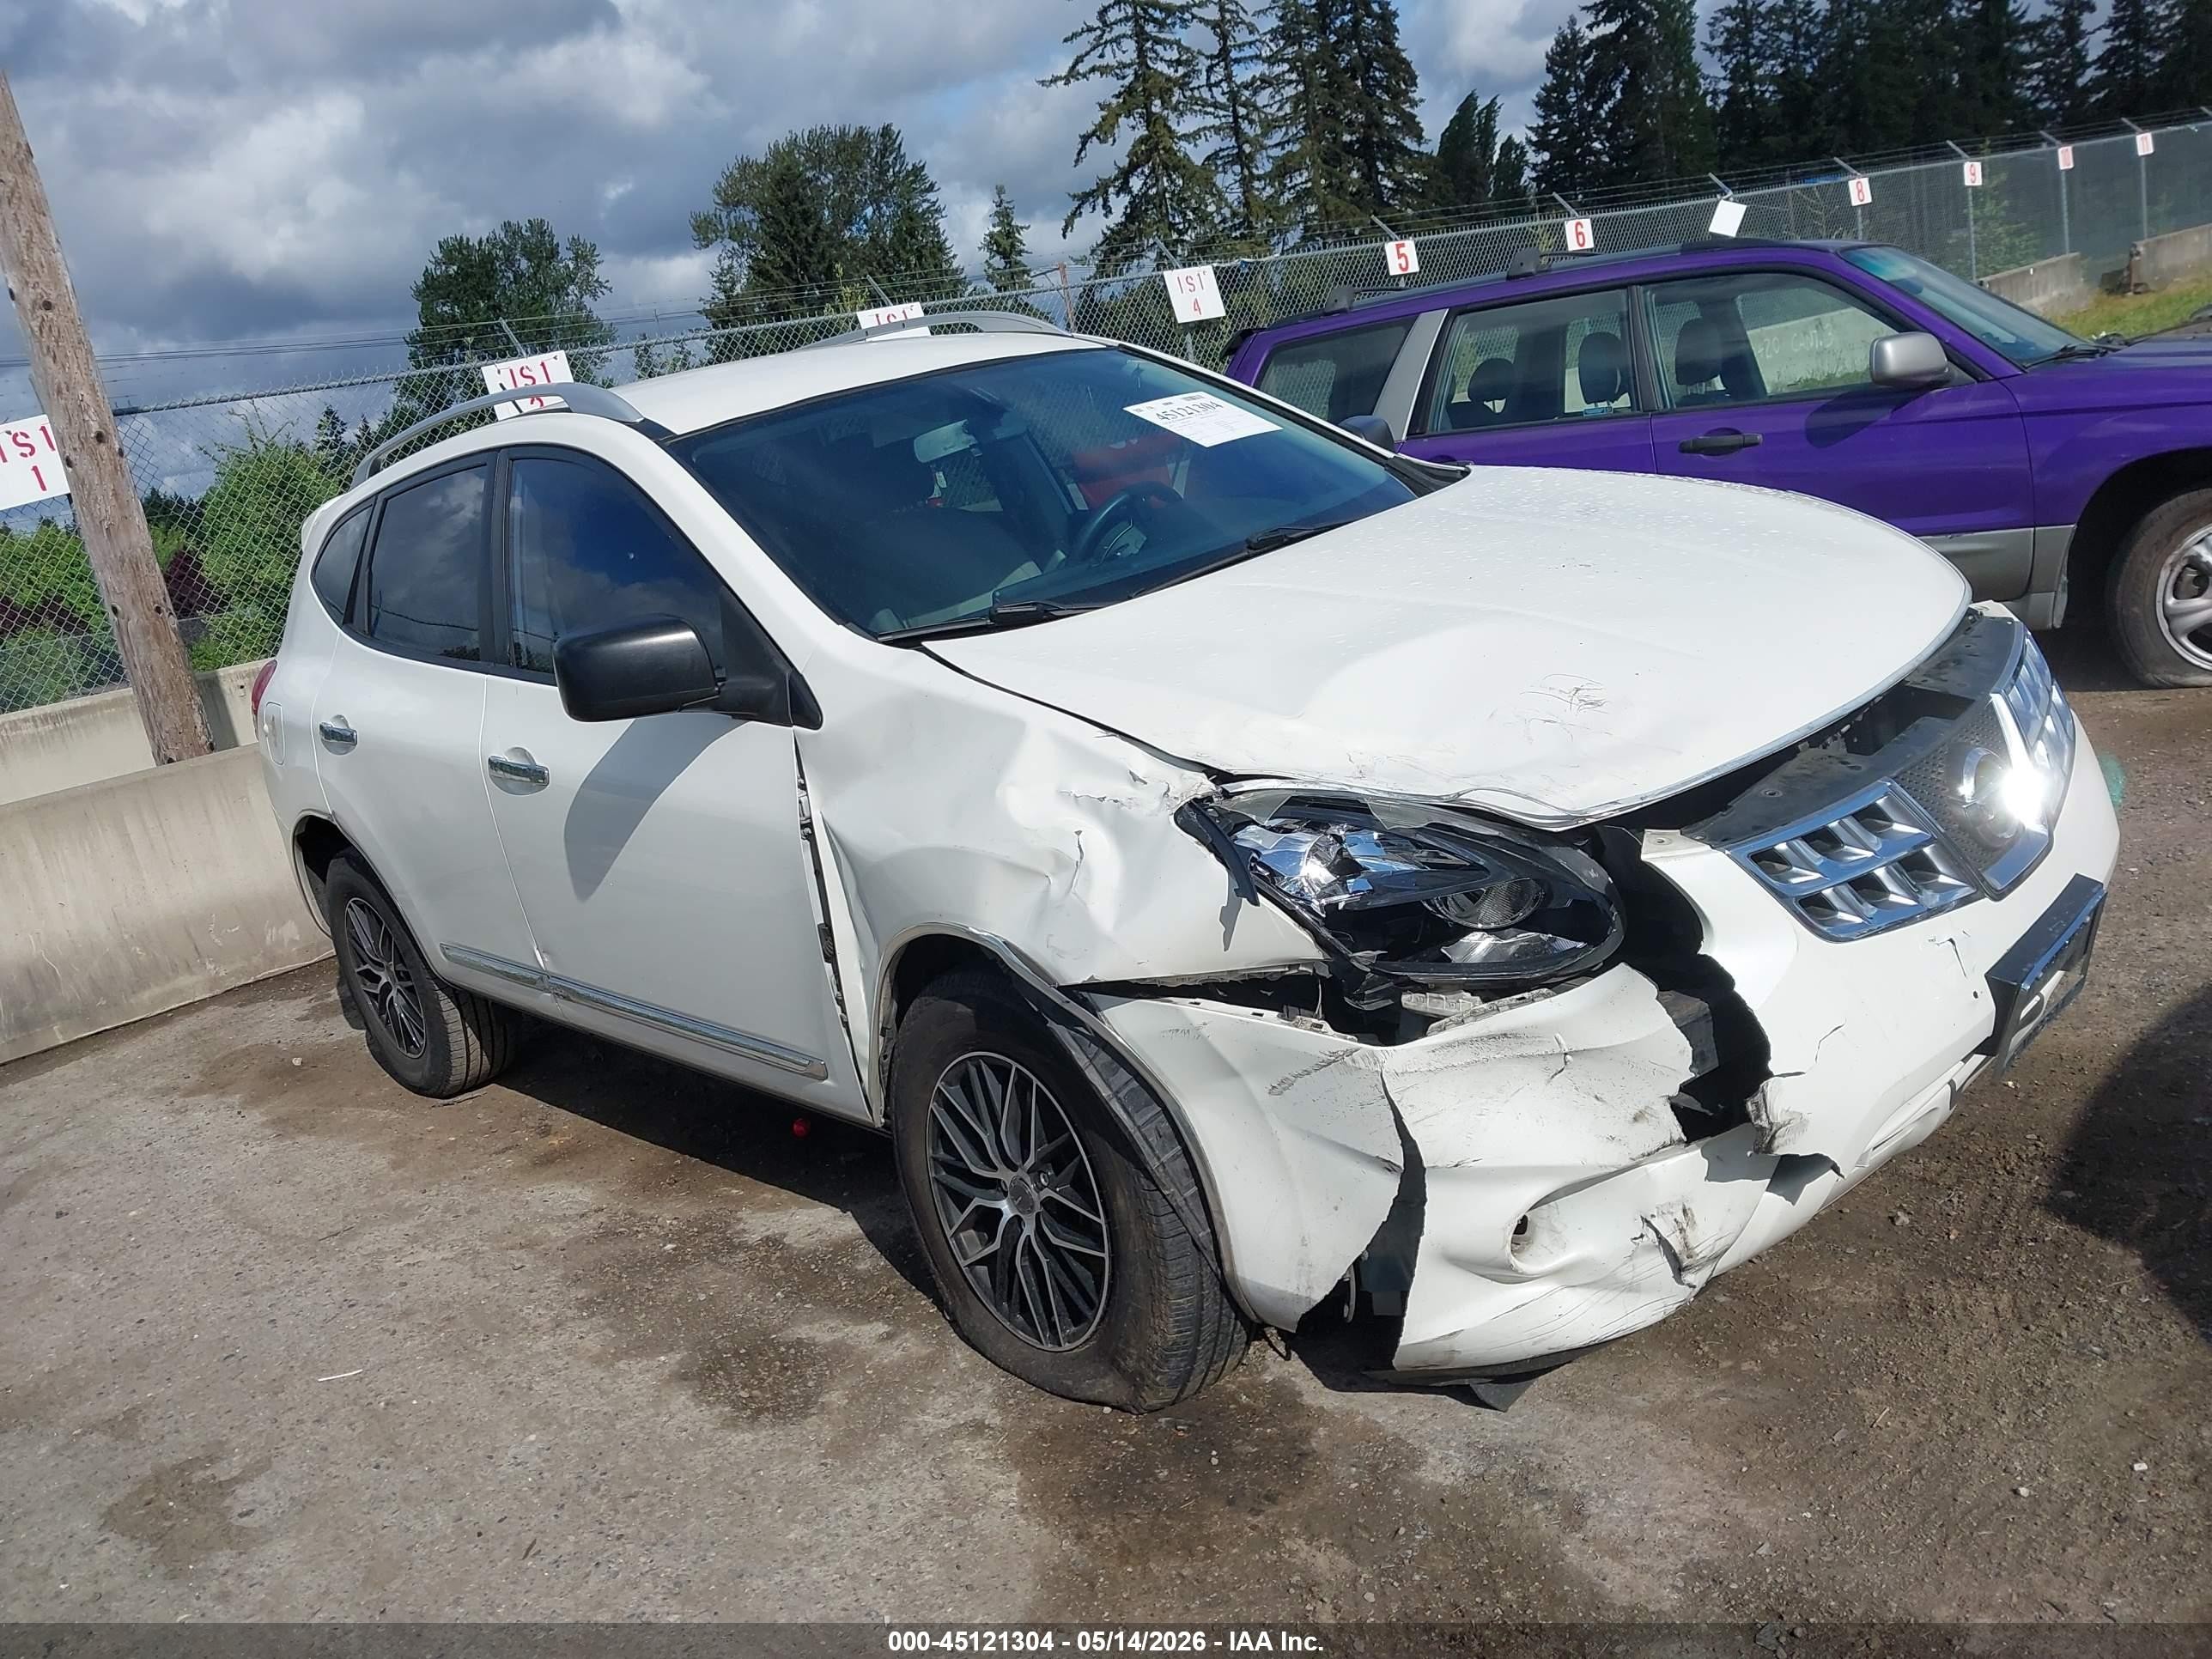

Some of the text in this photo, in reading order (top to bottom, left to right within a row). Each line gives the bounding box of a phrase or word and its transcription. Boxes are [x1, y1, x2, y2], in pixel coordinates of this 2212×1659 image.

[1969, 163, 1977, 184] 9
[1856, 180, 1865, 202] 8
[1575, 221, 1586, 247] 6
[1395, 242, 1409, 272] 5
[1194, 297, 1201, 315] 4
[1155, 400, 1224, 421] 45121304
